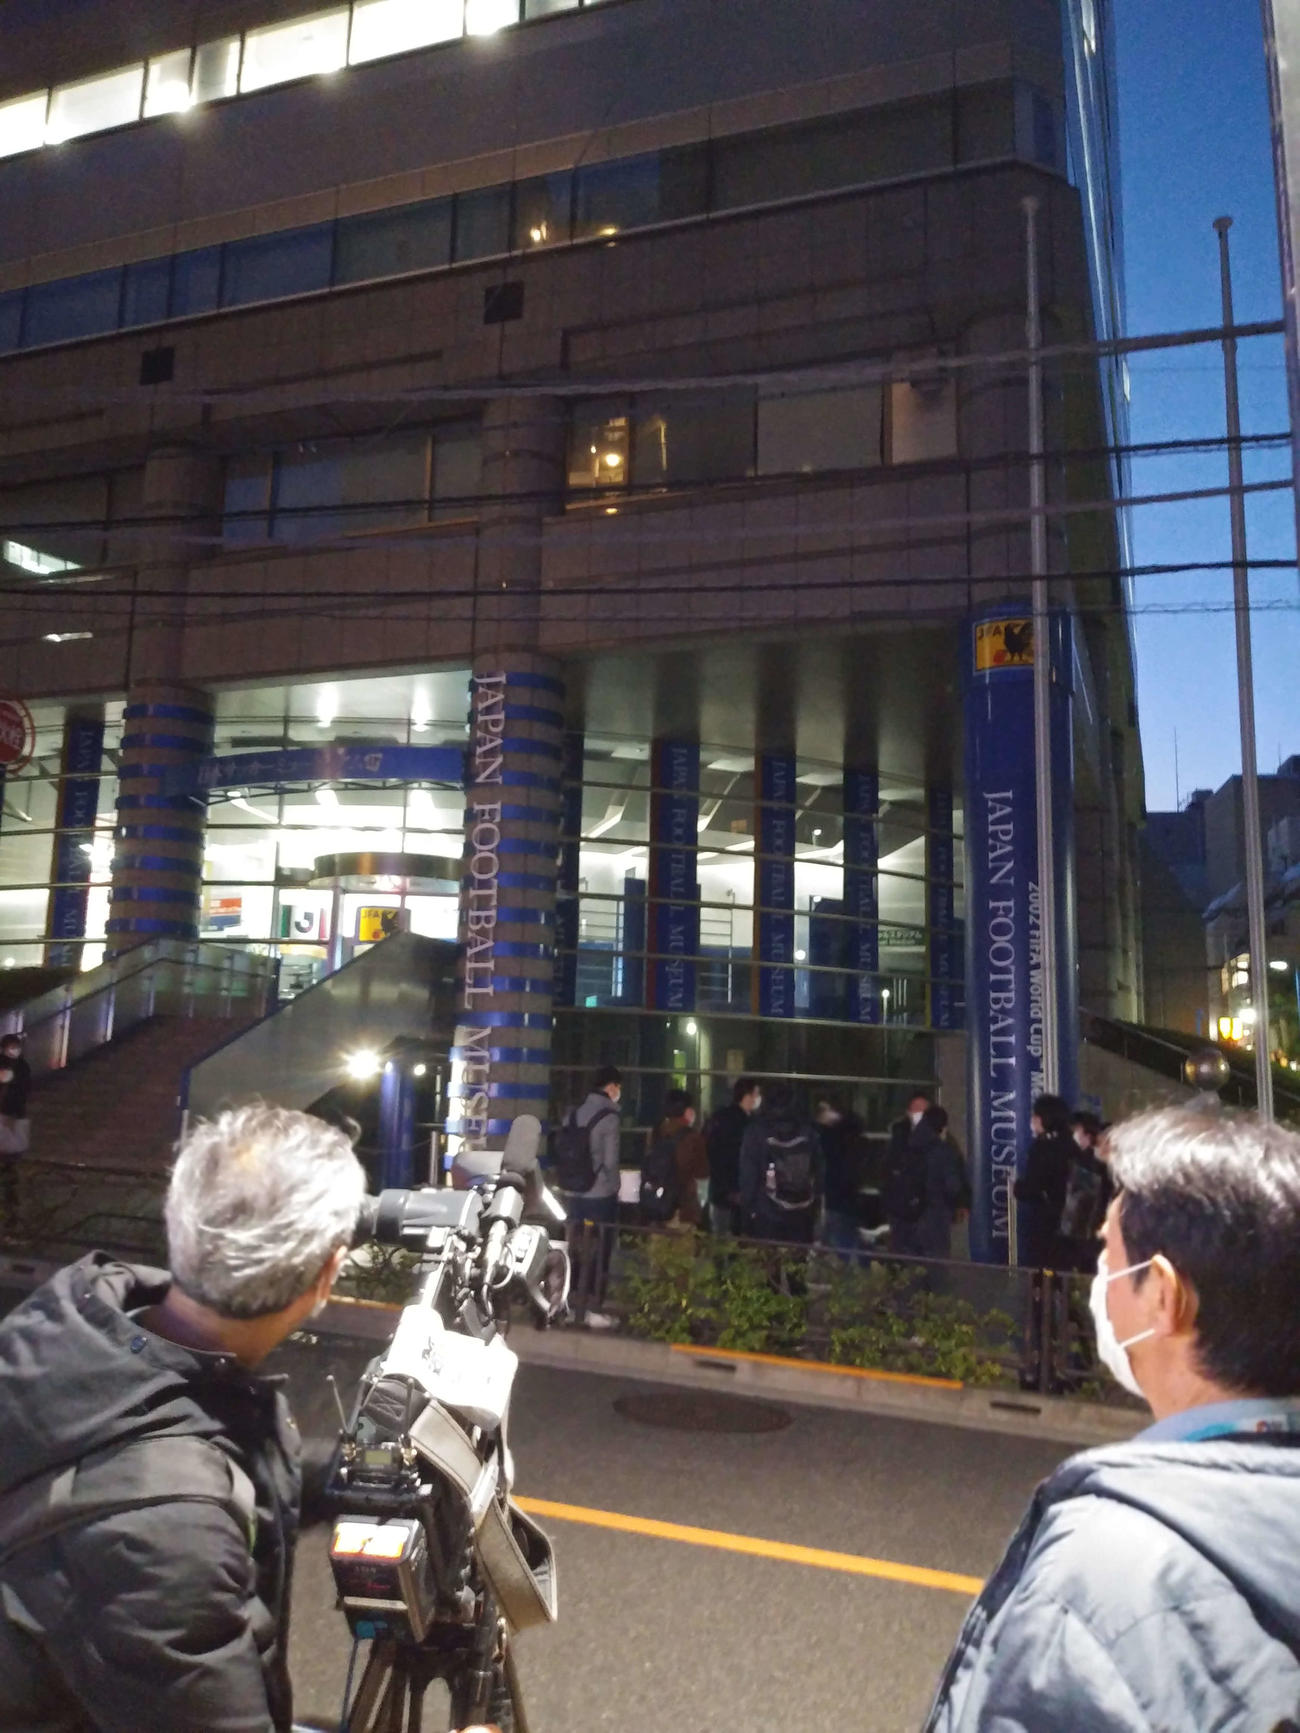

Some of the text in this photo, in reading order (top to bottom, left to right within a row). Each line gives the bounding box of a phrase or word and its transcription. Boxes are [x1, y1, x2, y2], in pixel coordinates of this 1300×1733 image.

[474, 671, 506, 785] JAPAN
[464, 800, 501, 1010] FOOTBALL
[1028, 881, 1041, 925] 2002
[1029, 929, 1042, 965] FIFA
[983, 789, 1018, 1238] JAPAN FOOTBALL MUSEUM
[1029, 968, 1043, 1018] World
[1026, 1022, 1043, 1057] Cup
